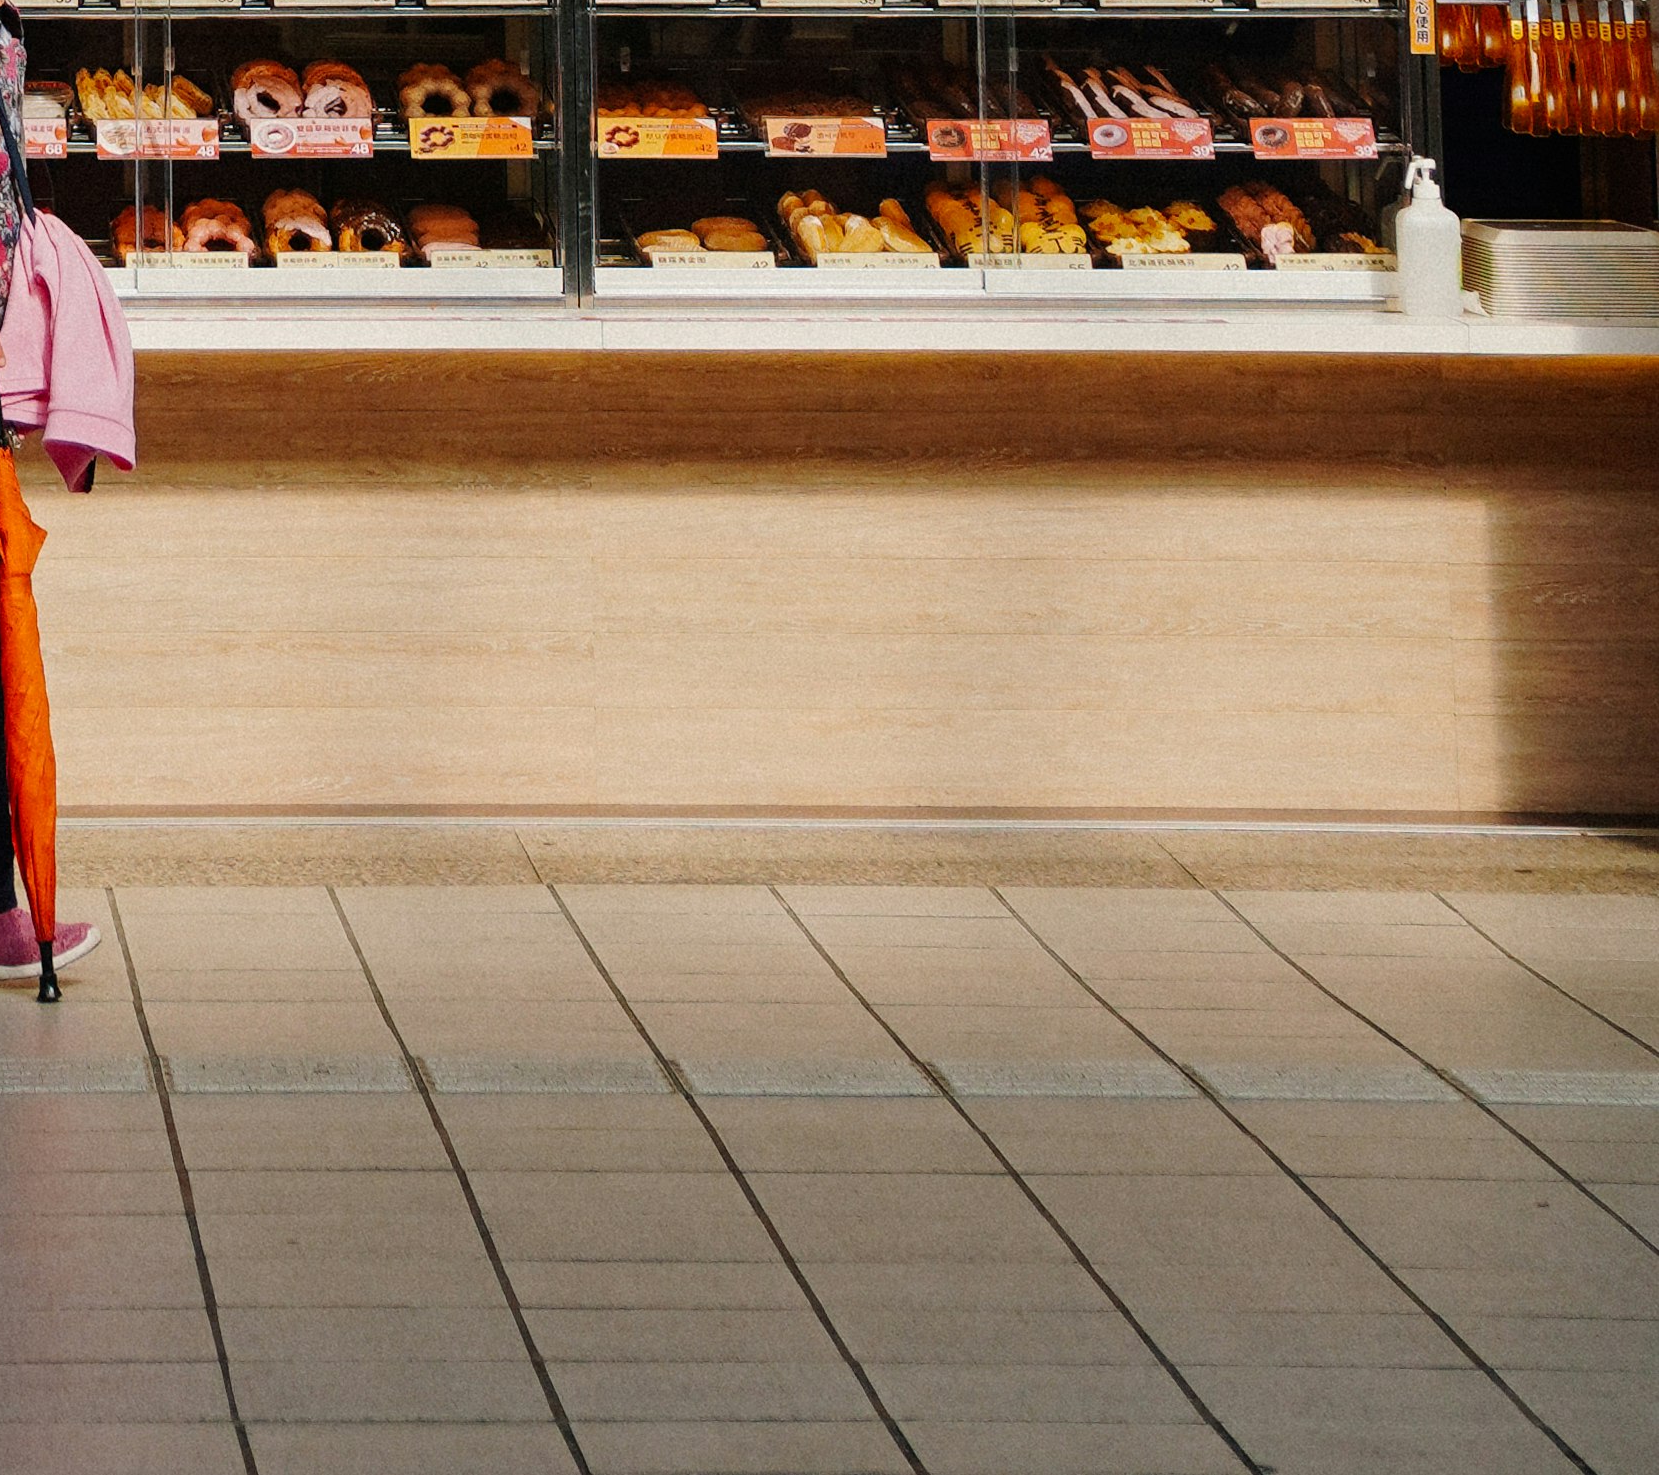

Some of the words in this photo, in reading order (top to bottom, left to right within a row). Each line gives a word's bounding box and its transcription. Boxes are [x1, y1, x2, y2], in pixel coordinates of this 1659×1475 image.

[46, 144, 63, 155] 68
[197, 146, 214, 157] 48
[351, 143, 369, 154] 48
